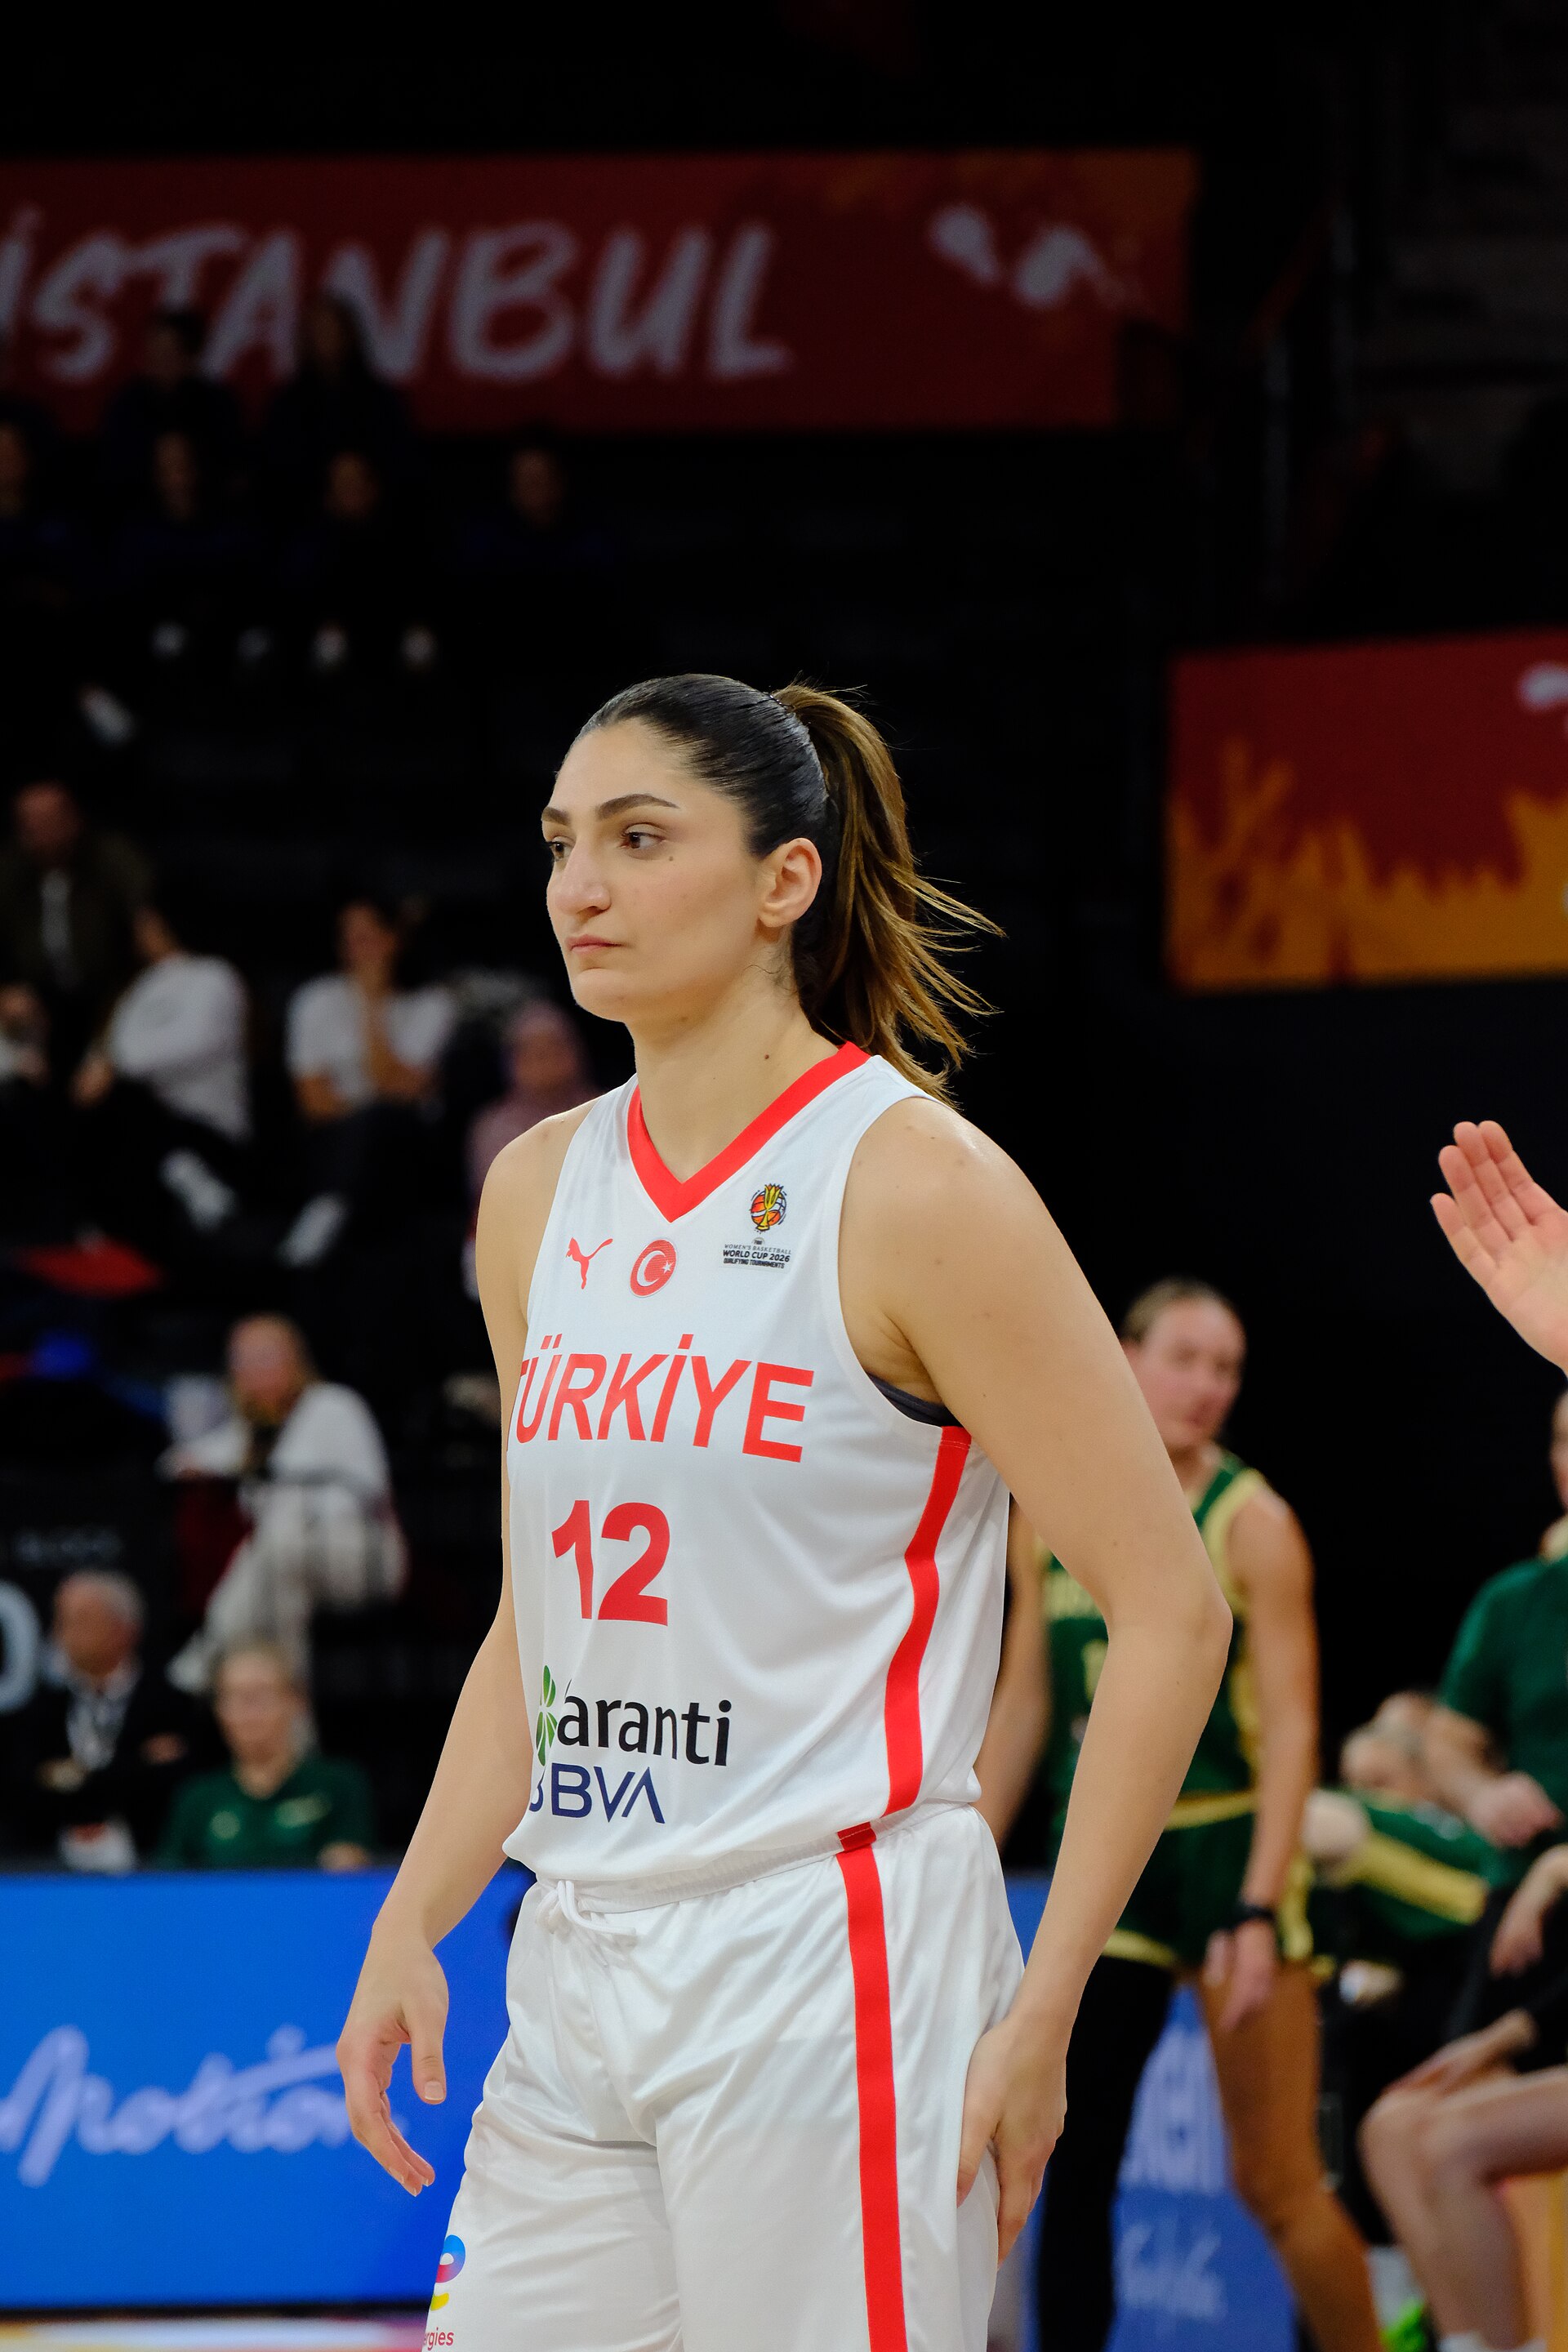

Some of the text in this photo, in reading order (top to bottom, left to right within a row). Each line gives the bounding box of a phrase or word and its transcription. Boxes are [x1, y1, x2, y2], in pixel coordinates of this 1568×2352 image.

[0, 201, 792, 385] İSTANBUL
[750, 1259, 785, 1268] TOURNAMENTS
[752, 1245, 791, 1254] BASKETBALL
[551, 1499, 670, 1627] 12
[557, 1682, 732, 1766] aranti
[423, 2327, 455, 2351] rgies
